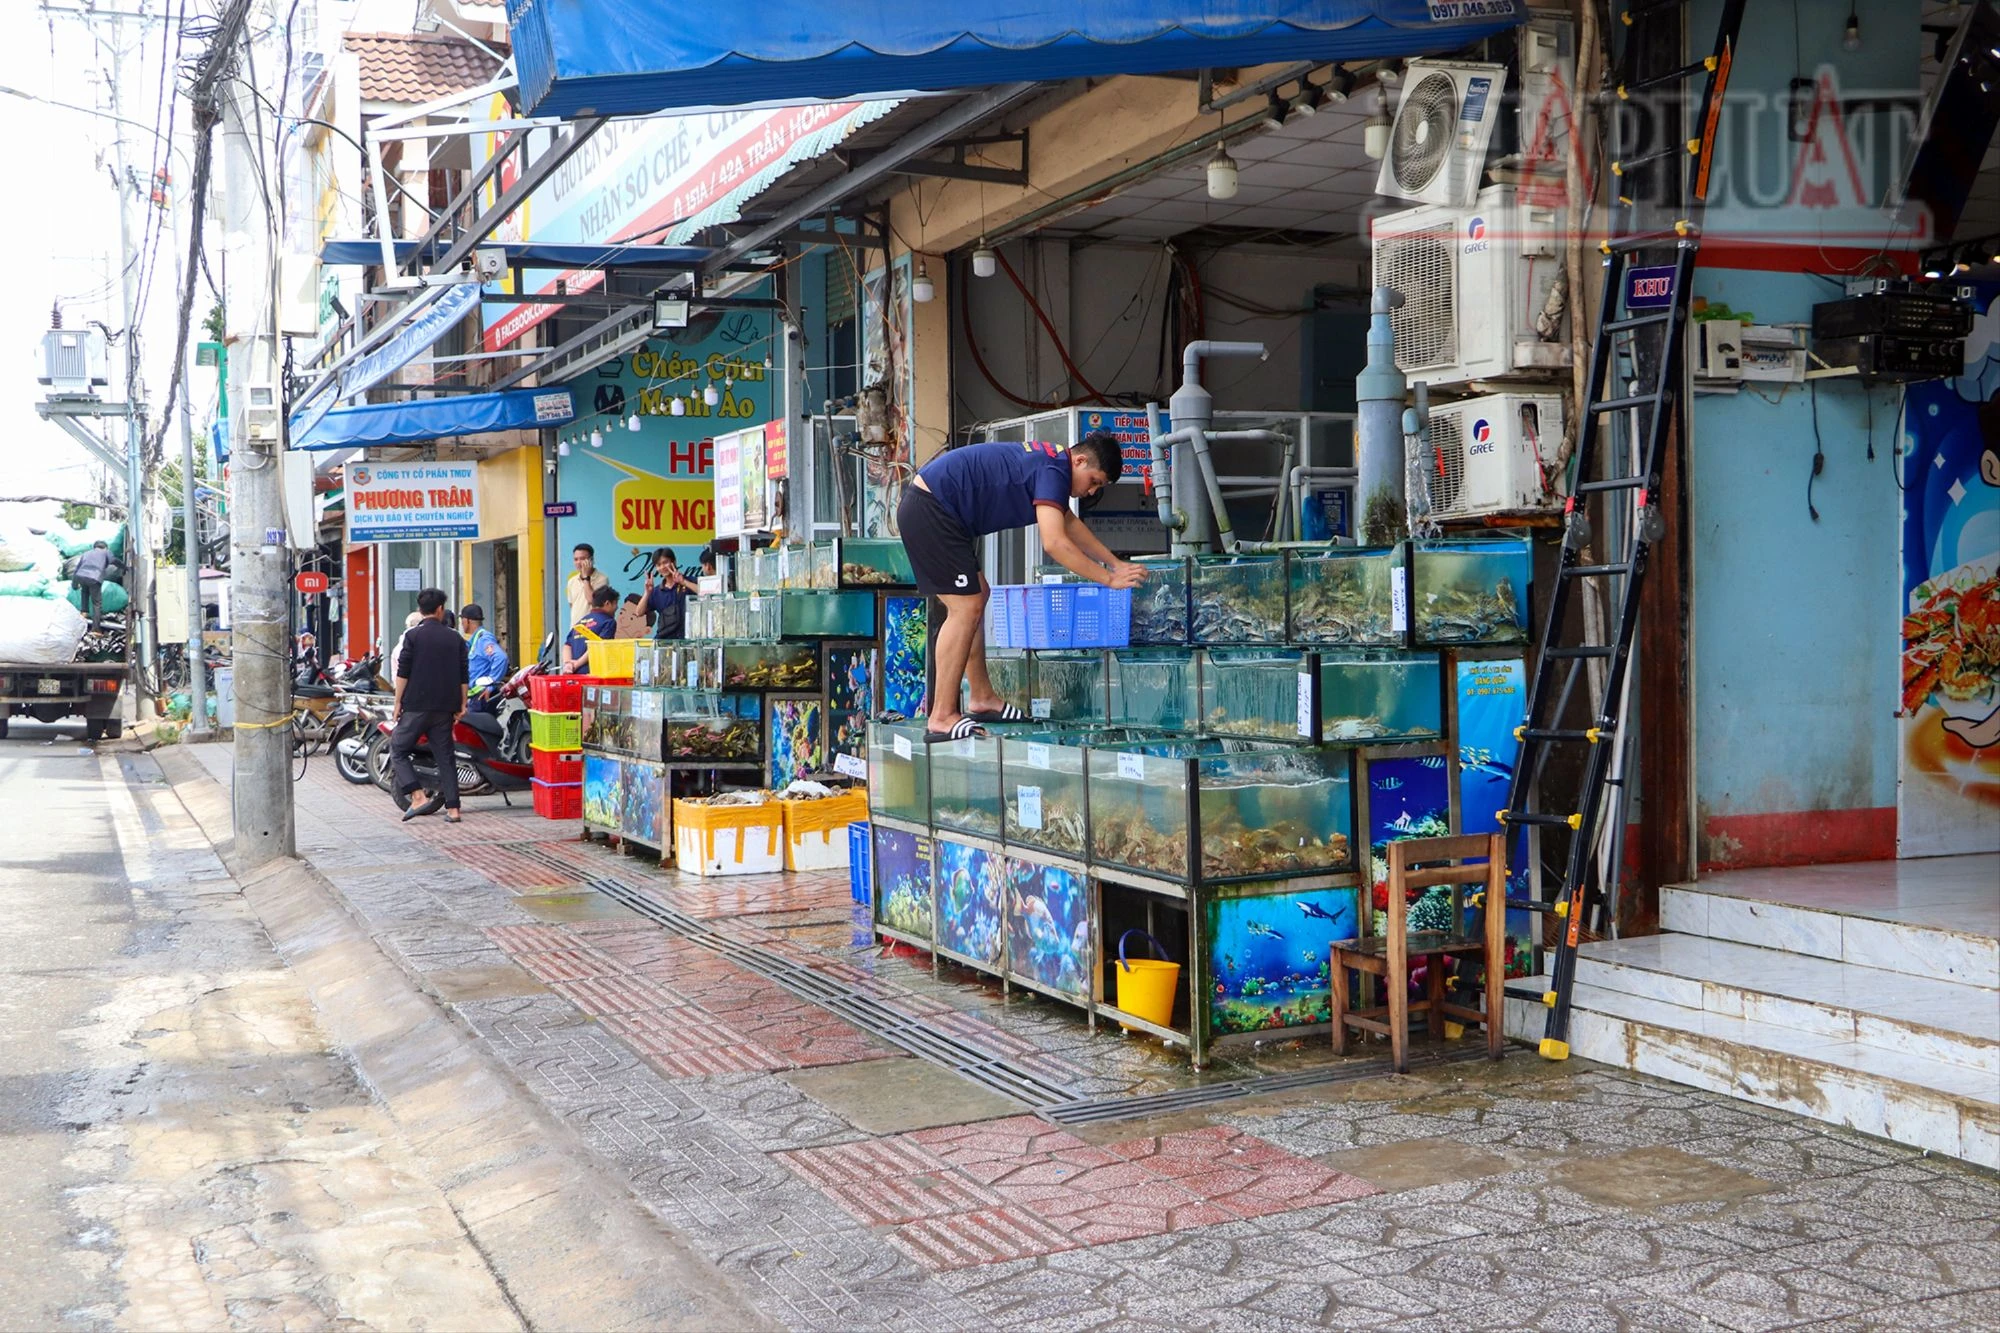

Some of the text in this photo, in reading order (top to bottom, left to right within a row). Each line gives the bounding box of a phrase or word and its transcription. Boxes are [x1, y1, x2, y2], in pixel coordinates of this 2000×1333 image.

[718, 155, 745, 185] 42A
[1464, 240, 1488, 255] GREE
[1633, 276, 1670, 298] KHU
[719, 313, 763, 345] Là
[631, 351, 765, 382] Chén Cơm
[718, 384, 755, 418] Áo
[1113, 413, 1150, 429] TIẾP NHẬ
[1469, 442, 1495, 456] GREE
[376, 469, 399, 480] CÔNG
[401, 470, 411, 479] TY
[353, 484, 474, 511] PHƯƠNG TRÂN
[354, 511, 474, 524] DỊCH VỤ BẢO VỆ CHUYÊN NGHIỆP
[546, 505, 564, 514] KHU
[621, 498, 666, 531] SUY
